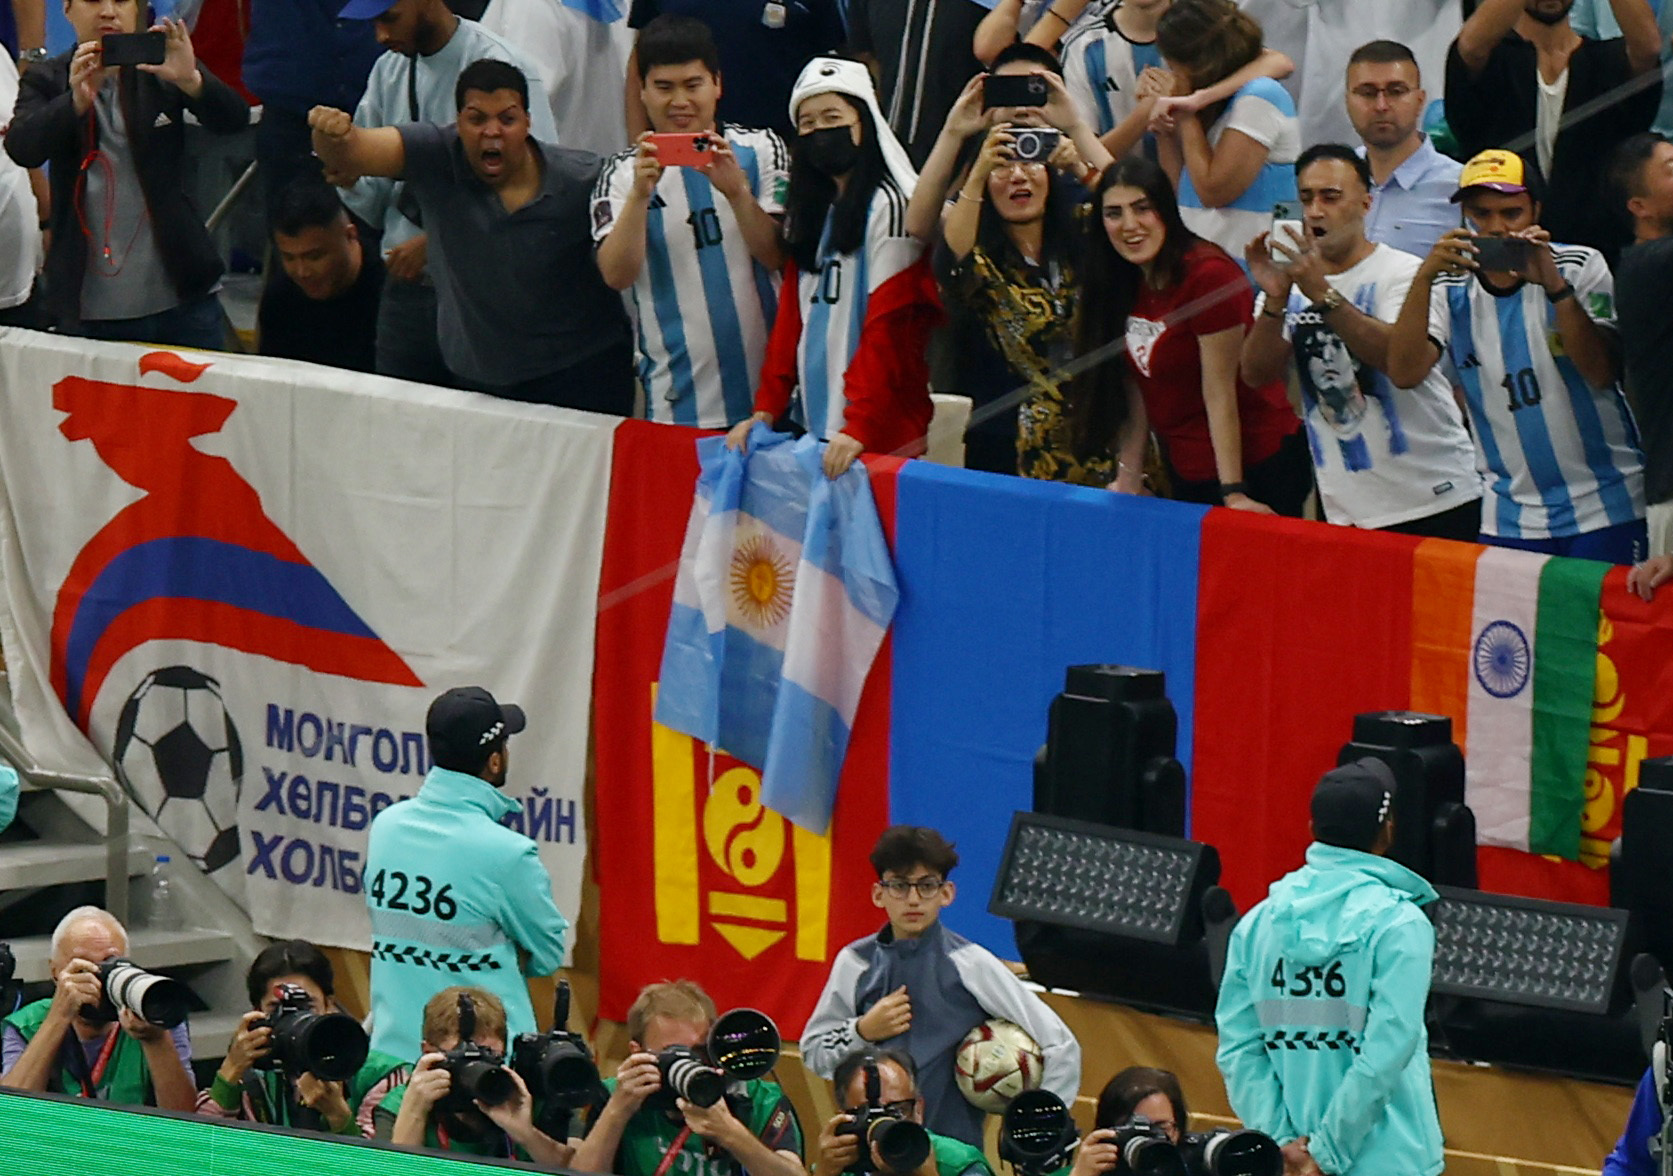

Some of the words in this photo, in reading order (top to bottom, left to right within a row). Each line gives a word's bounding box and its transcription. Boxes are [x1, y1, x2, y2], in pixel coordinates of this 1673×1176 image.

[686, 207, 723, 249] 10
[811, 259, 842, 304] 0
[1501, 367, 1542, 412] 10
[266, 703, 434, 776] МОНГОЛ
[247, 829, 366, 894] ХОЛБ
[371, 868, 457, 921] 4236
